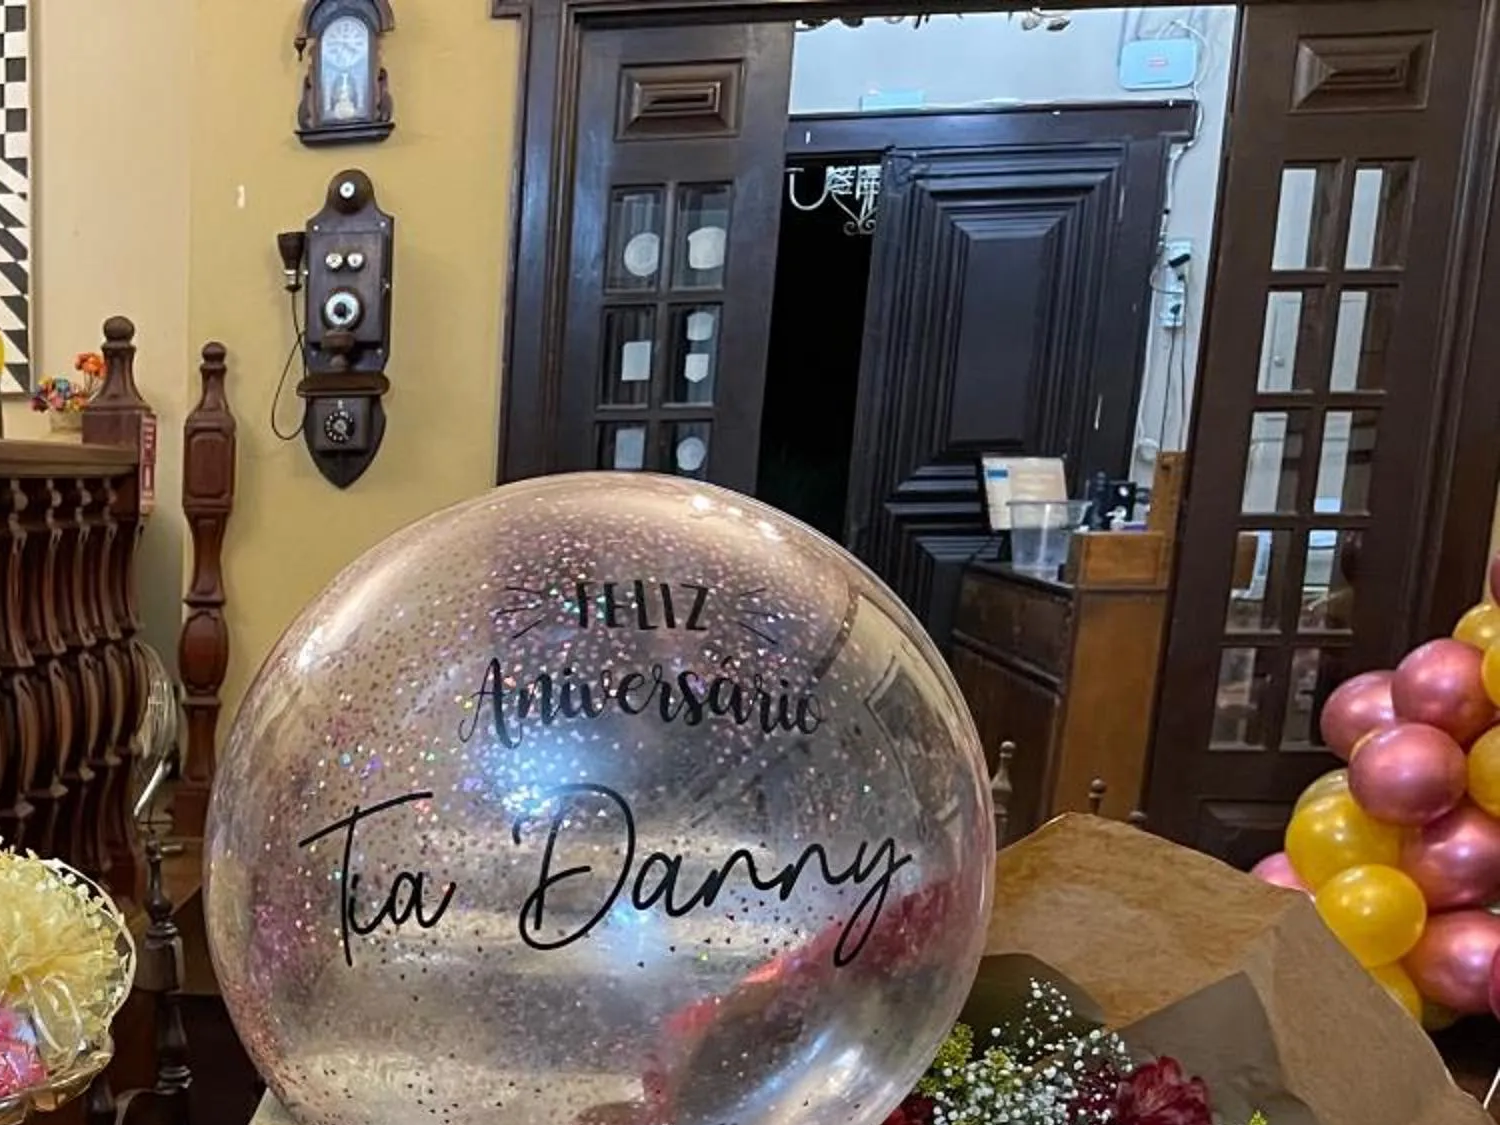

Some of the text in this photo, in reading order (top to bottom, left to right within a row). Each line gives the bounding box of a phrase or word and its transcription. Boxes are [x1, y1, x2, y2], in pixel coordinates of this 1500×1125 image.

[573, 580, 711, 632] FELIZ
[458, 656, 826, 750] Aniversário
[300, 783, 912, 968] Tia Danny
